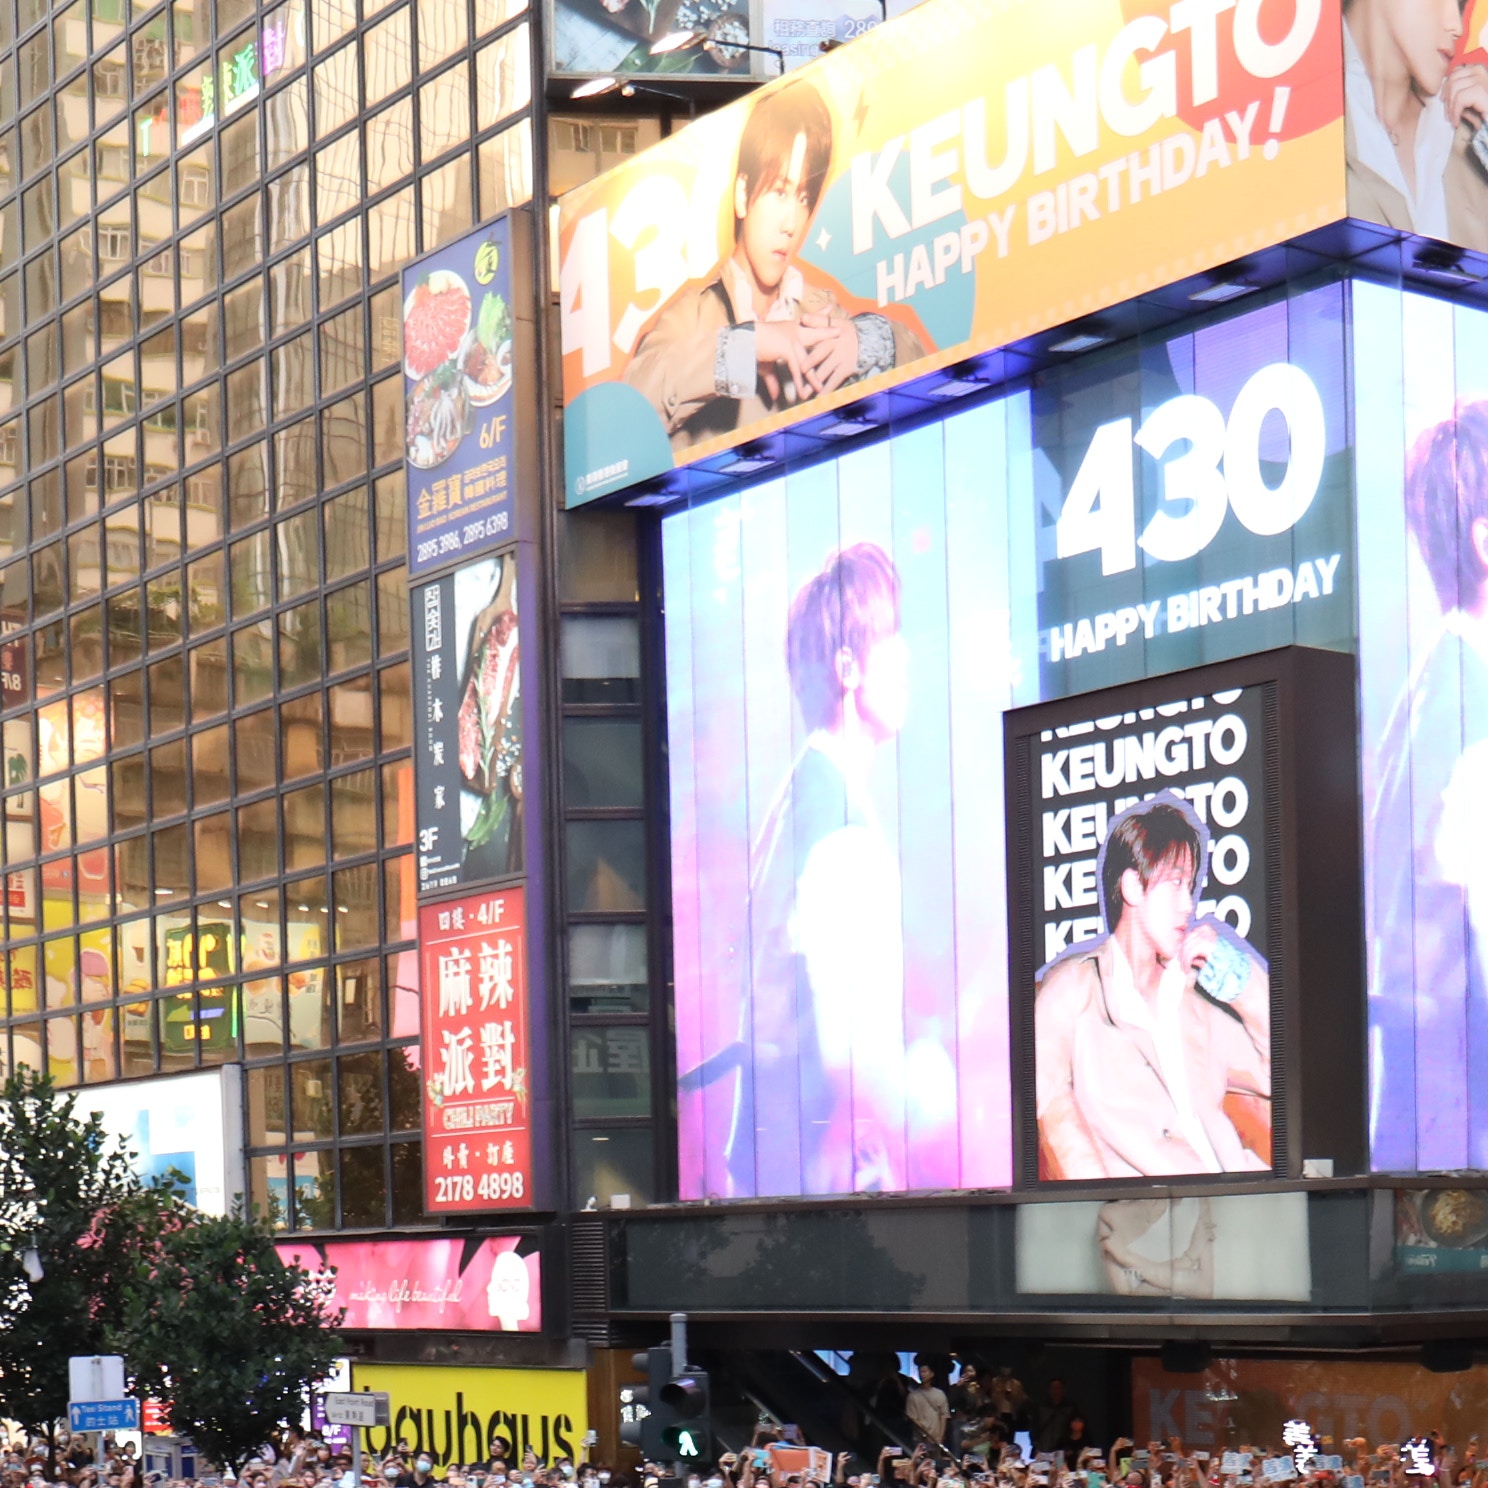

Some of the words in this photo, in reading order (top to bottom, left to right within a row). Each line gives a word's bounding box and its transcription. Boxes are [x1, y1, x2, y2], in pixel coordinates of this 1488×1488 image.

[850, 0, 1322, 256] KEUNGTO
[876, 204, 1019, 309] HAPPY
[1028, 86, 1292, 247] BIRTHDAY!
[479, 414, 507, 449] 6/F
[1056, 361, 1327, 577] 430
[1050, 600, 1162, 663] HAPPY
[1167, 553, 1341, 634] BIRTHDAY
[1040, 713, 1249, 799] KEUNGTO
[419, 826, 440, 853] 3F
[476, 898, 505, 925] 4/F
[438, 938, 515, 1019] 麻辣
[440, 1020, 516, 1097] 派對
[434, 1174, 475, 1203] 2178
[477, 1171, 524, 1201] 4898
[98, 1403, 123, 1413] Stand
